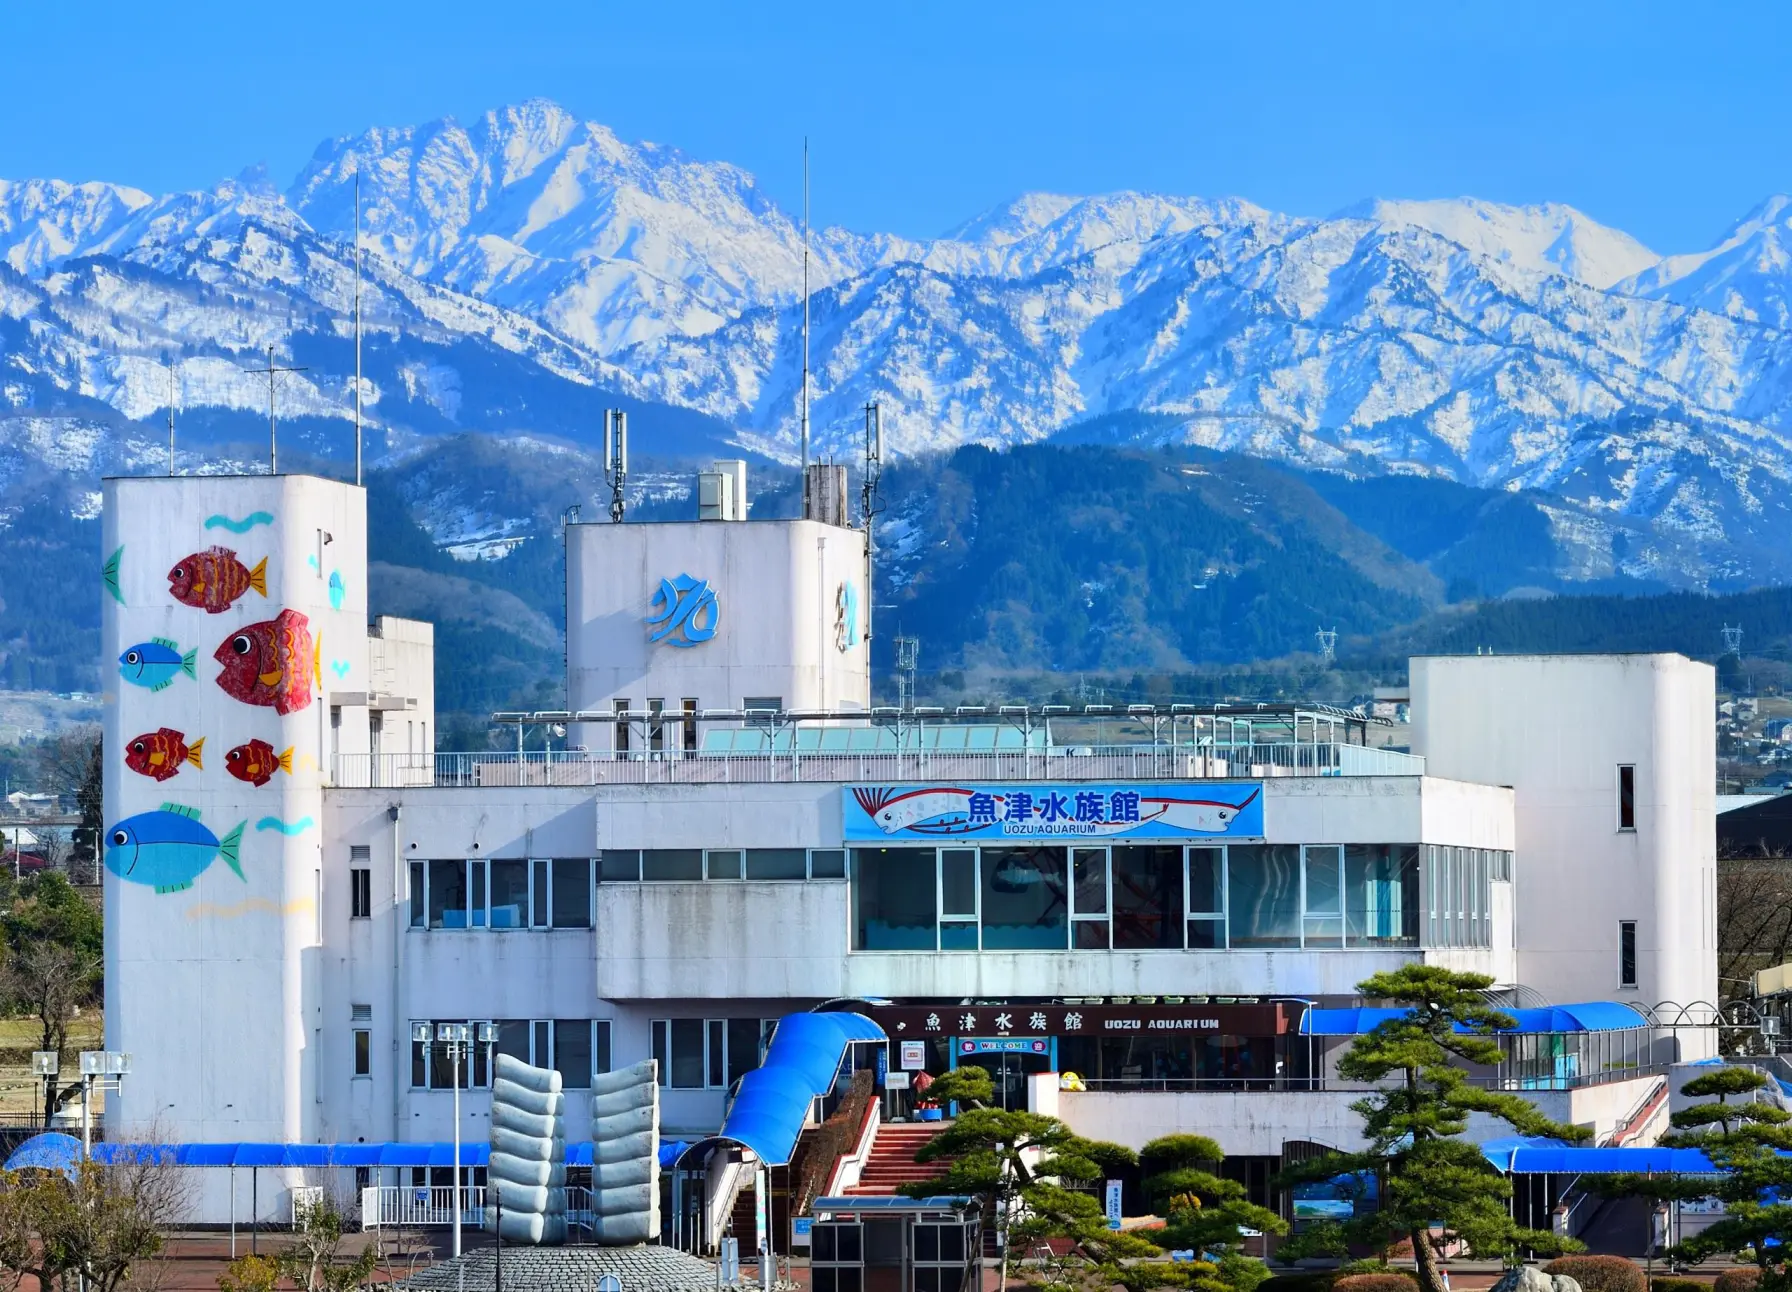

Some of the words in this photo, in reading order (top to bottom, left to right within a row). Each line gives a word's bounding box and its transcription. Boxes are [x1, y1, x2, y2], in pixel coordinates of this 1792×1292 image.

[967, 791, 1140, 823] 魚津水族館
[1003, 824, 1034, 834] UOZU
[1037, 824, 1096, 834] AQUARIUM
[924, 1012, 1084, 1031] 魚津水族館
[1104, 1019, 1141, 1029] UOZU
[1147, 1019, 1219, 1029] AQUARIUM
[981, 1041, 1027, 1050] WELCOME
